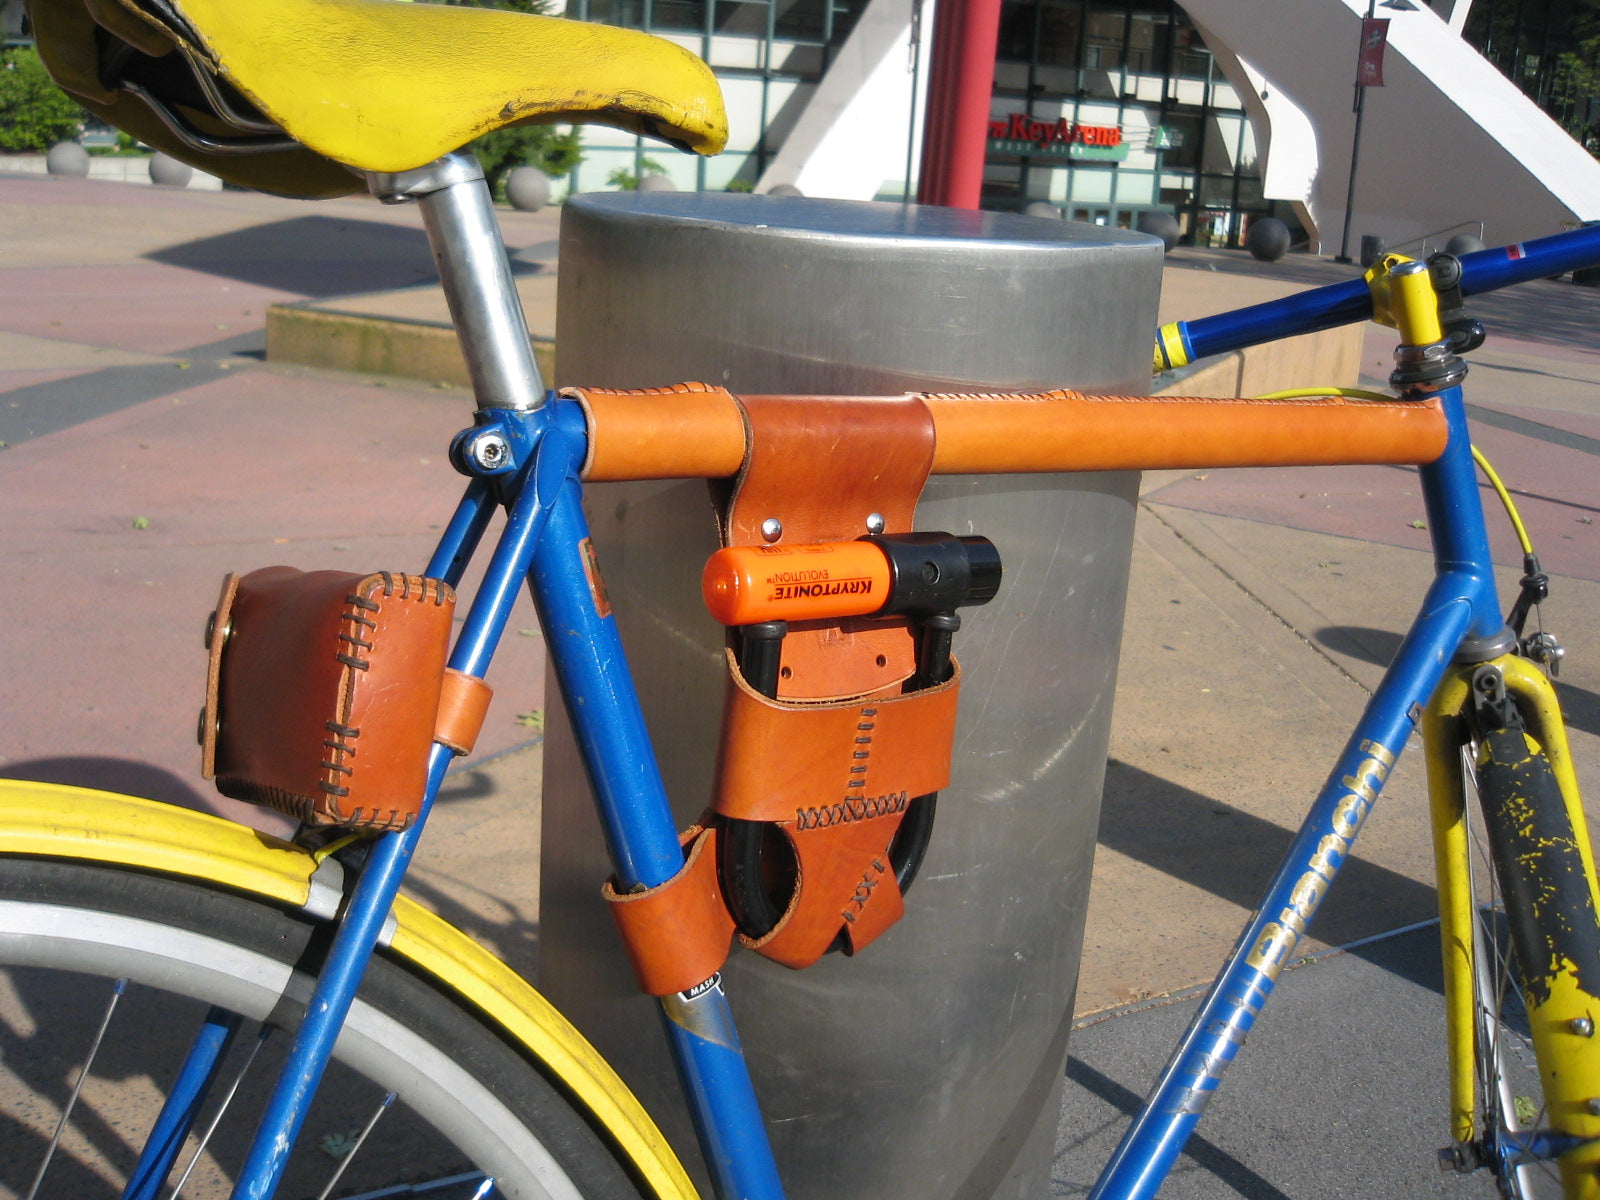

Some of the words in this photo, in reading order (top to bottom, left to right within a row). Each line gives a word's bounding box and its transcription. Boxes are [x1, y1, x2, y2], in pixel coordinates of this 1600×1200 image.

[1010, 113, 1121, 148] KeyArena
[1244, 739, 1395, 981] Bianchi
[690, 976, 715, 996] MASH
